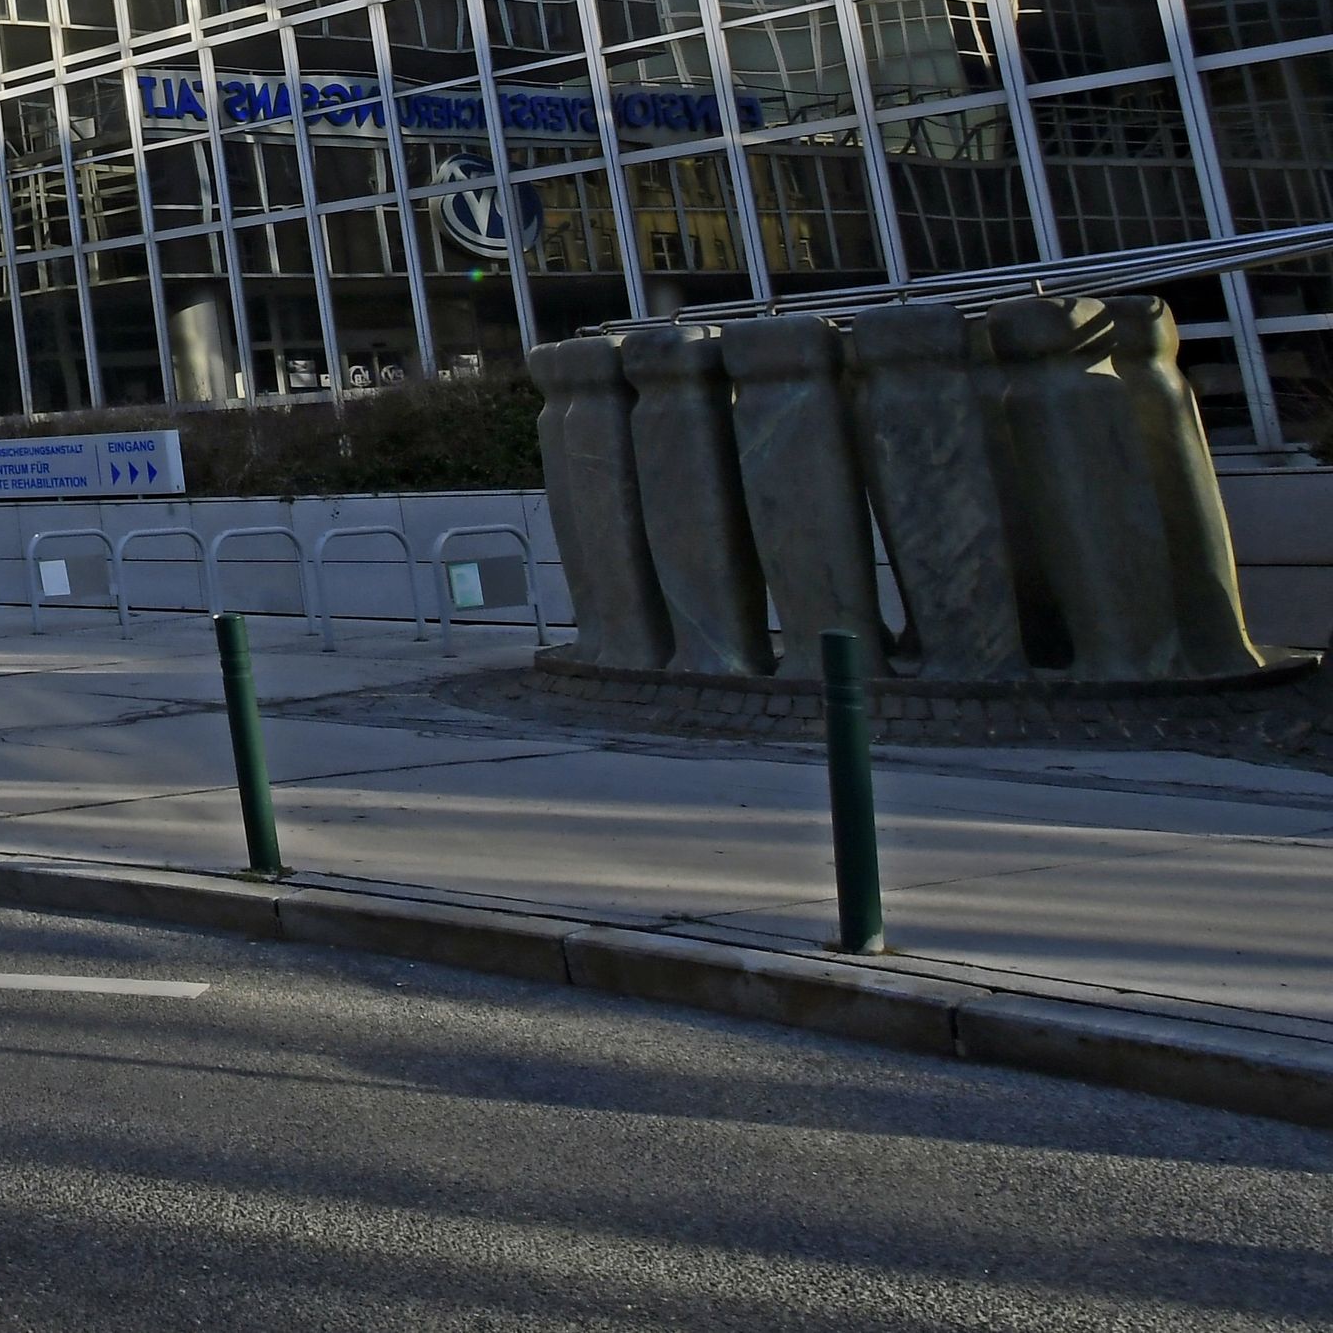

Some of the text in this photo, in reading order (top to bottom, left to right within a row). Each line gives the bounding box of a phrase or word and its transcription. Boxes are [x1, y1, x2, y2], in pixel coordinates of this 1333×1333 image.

[108, 441, 155, 453] EINGANG
[30, 461, 50, 474] FÜR
[11, 476, 87, 489] REHABILITATION
